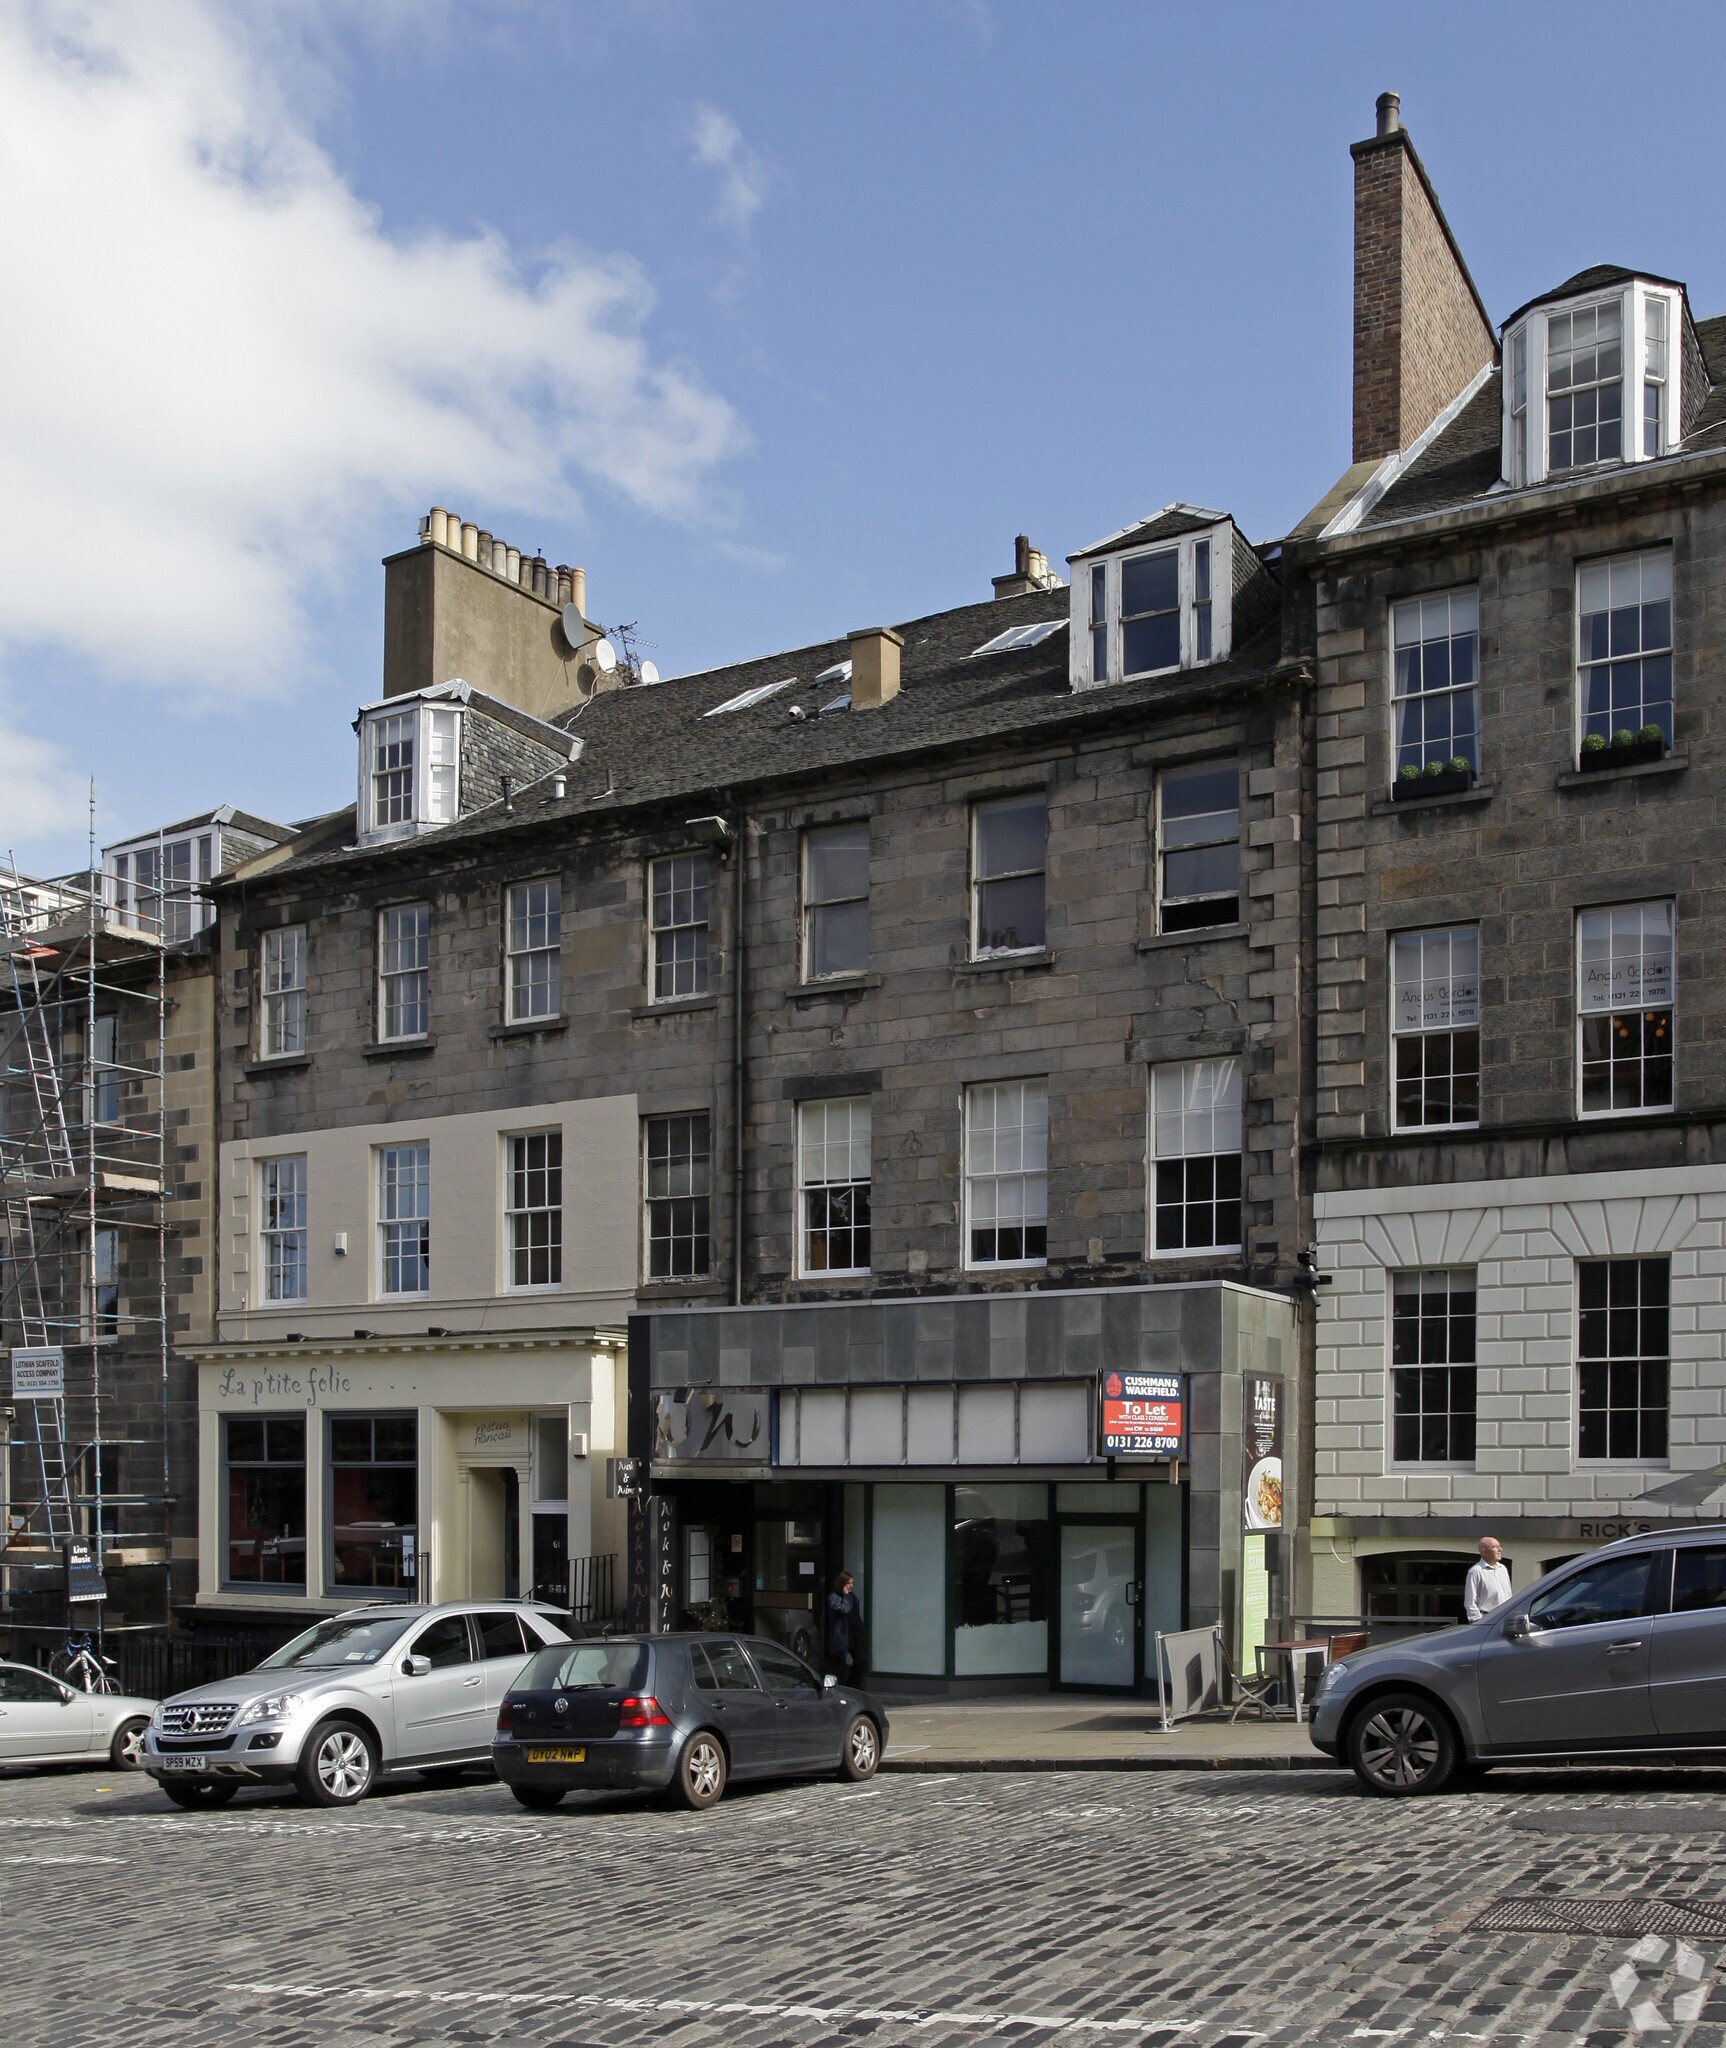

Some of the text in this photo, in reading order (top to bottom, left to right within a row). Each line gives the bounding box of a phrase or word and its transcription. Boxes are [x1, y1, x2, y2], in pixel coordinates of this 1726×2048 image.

[1588, 961, 1671, 986] Angus Gordon
[1402, 984, 1479, 1008] Angus Gordon
[1630, 990, 1645, 998] 22
[1648, 987, 1666, 996] 1978
[1457, 1009, 1475, 1017] 1978
[16, 1360, 59, 1369] LOTHIAN SCAFFOLD
[17, 1369, 58, 1378] ACCESS COMPANY
[219, 1368, 246, 1397] La
[307, 1365, 351, 1406] folie
[1125, 1376, 1179, 1388] CUSHMAN &
[1122, 1402, 1166, 1415] To Let
[1254, 1397, 1276, 1411] TASTE
[1107, 1435, 1178, 1449] 0131 226 8700
[1580, 1522, 1651, 1538] RICK'S
[73, 1545, 88, 1554] Live
[71, 1554, 91, 1564] Music
[560, 1748, 581, 1759] NWP
[165, 1756, 203, 1768] SP59 MZX
